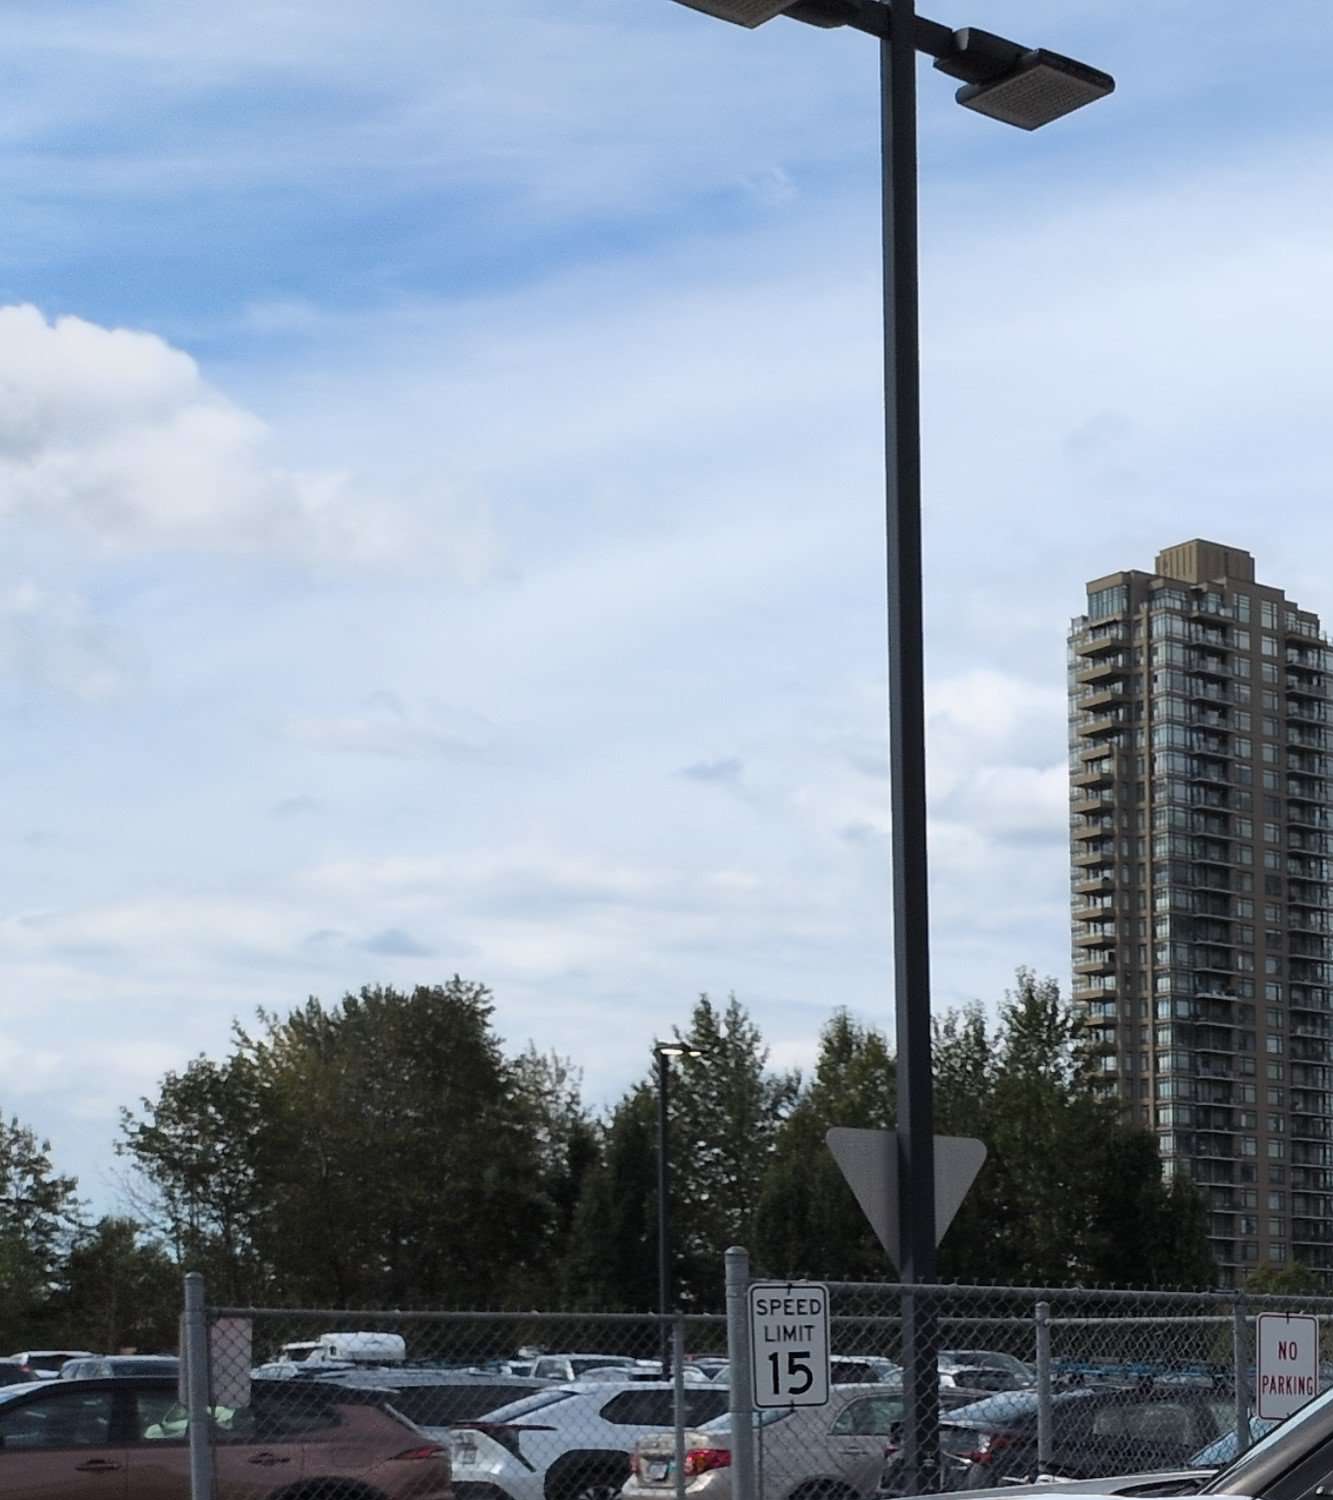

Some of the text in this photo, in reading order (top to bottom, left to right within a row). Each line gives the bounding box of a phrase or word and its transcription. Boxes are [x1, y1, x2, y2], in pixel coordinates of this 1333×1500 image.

[756, 1299, 822, 1316] SPEED
[764, 1325, 816, 1343] LIMIT
[1278, 1341, 1298, 1360] NO
[768, 1352, 813, 1395] 15
[1262, 1375, 1313, 1396] PARKING
